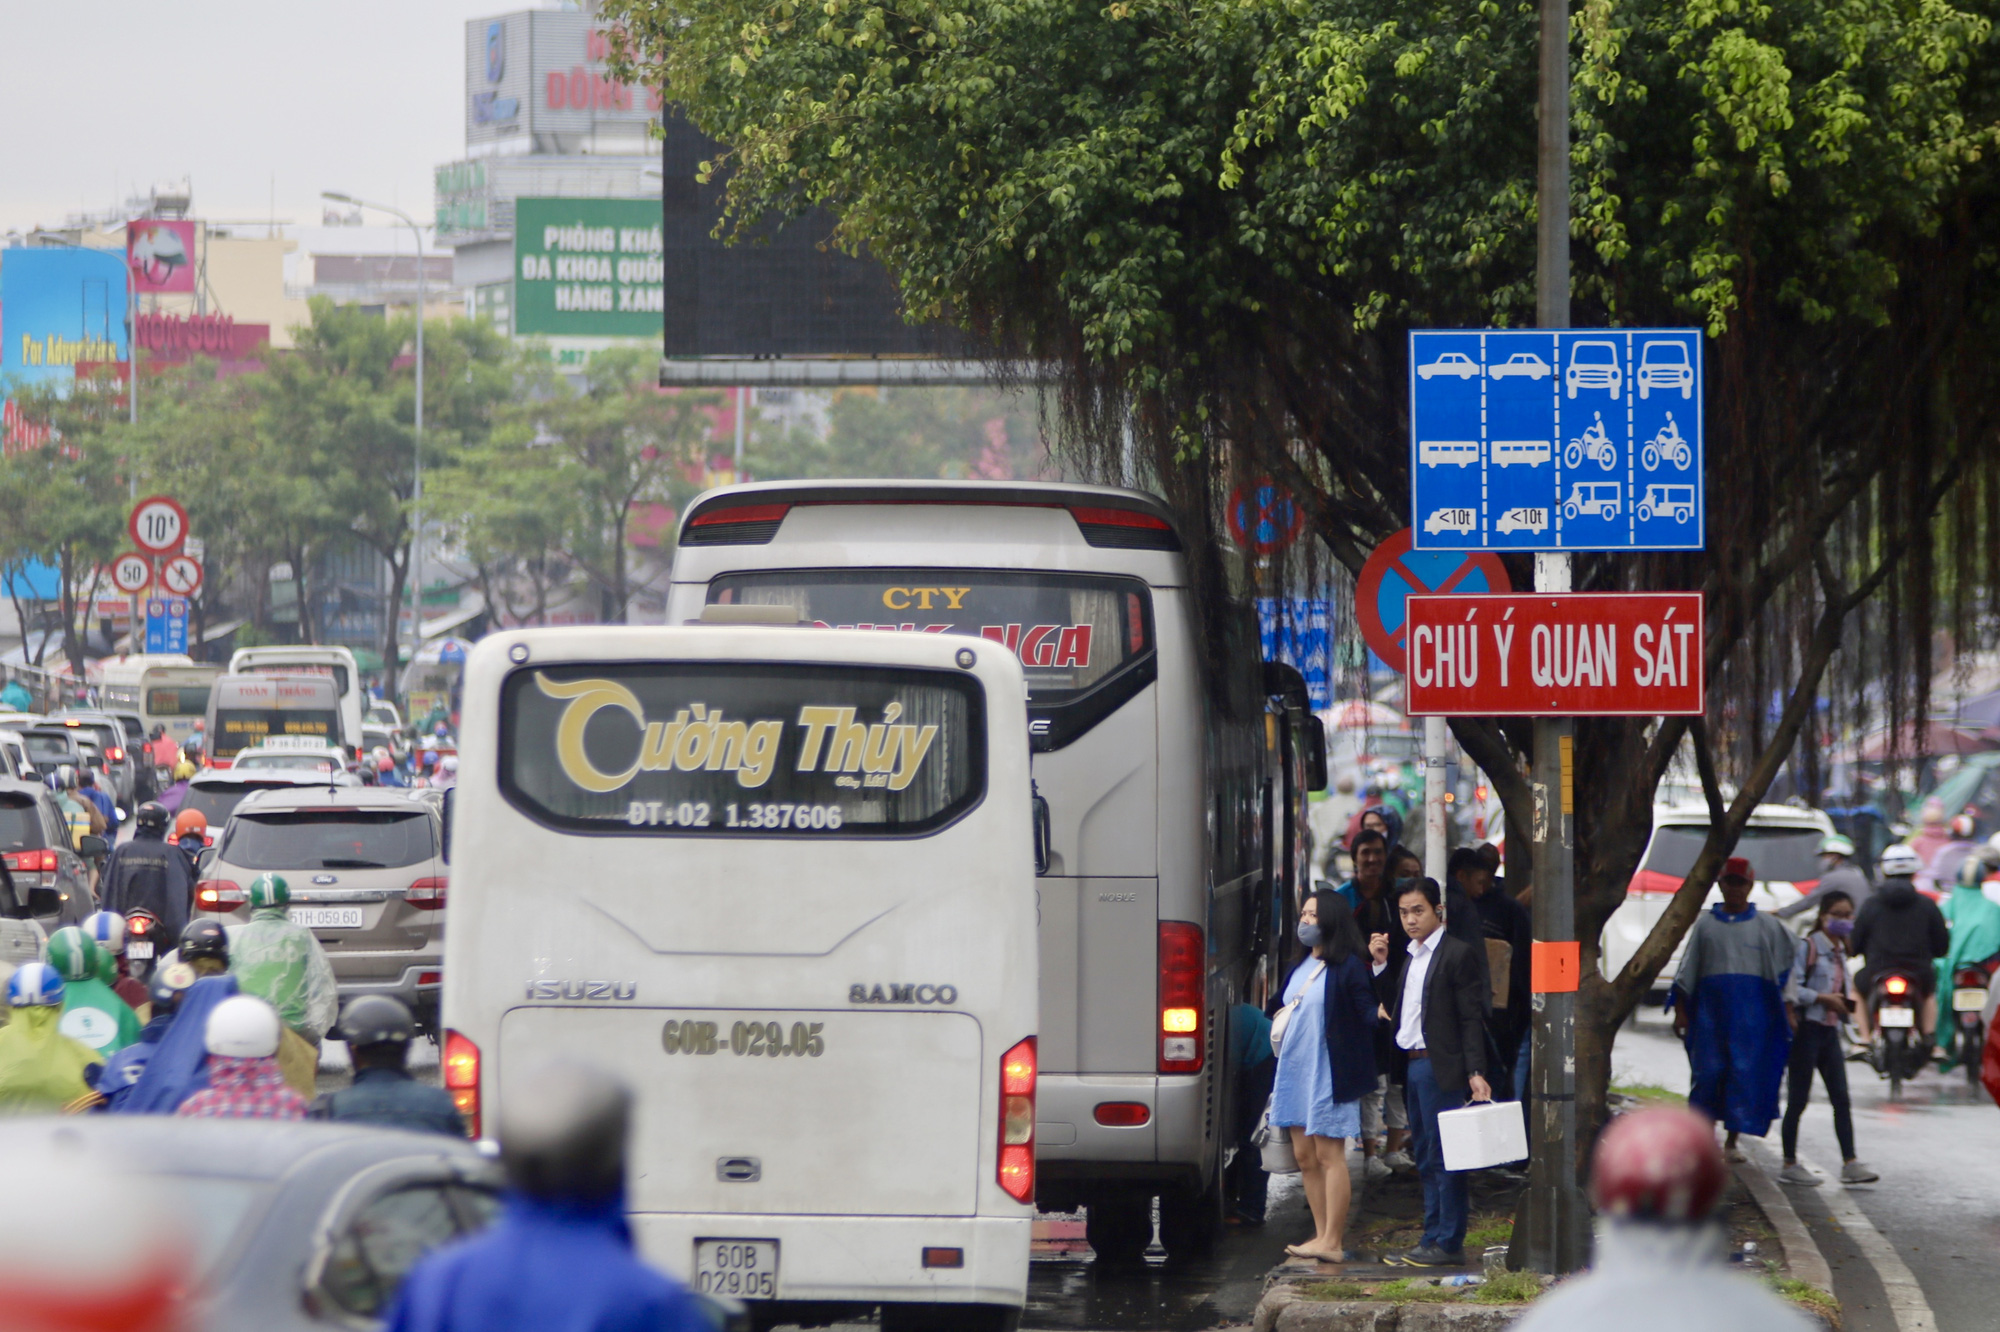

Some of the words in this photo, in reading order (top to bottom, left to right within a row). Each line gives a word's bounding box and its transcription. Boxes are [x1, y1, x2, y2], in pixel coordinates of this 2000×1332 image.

[544, 219, 615, 252] PHÒNG
[556, 255, 613, 282] KHOA
[617, 250, 663, 287] QUỐ
[555, 282, 613, 312] HÀNG
[123, 563, 141, 584] 50
[882, 587, 971, 610] CTY
[1413, 608, 1478, 688] CHÚ
[1493, 607, 1515, 687] Ý
[1531, 623, 1617, 688] QUAN
[1633, 606, 1694, 687] SÁT
[534, 670, 783, 793] Cường
[726, 803, 842, 829] 1.387606
[525, 979, 637, 1001] ISUZU
[848, 983, 958, 1005] SAMCO
[662, 1018, 825, 1057] 60B-029.05
[716, 1245, 757, 1269] 60B
[699, 1270, 773, 1295] 029.05
